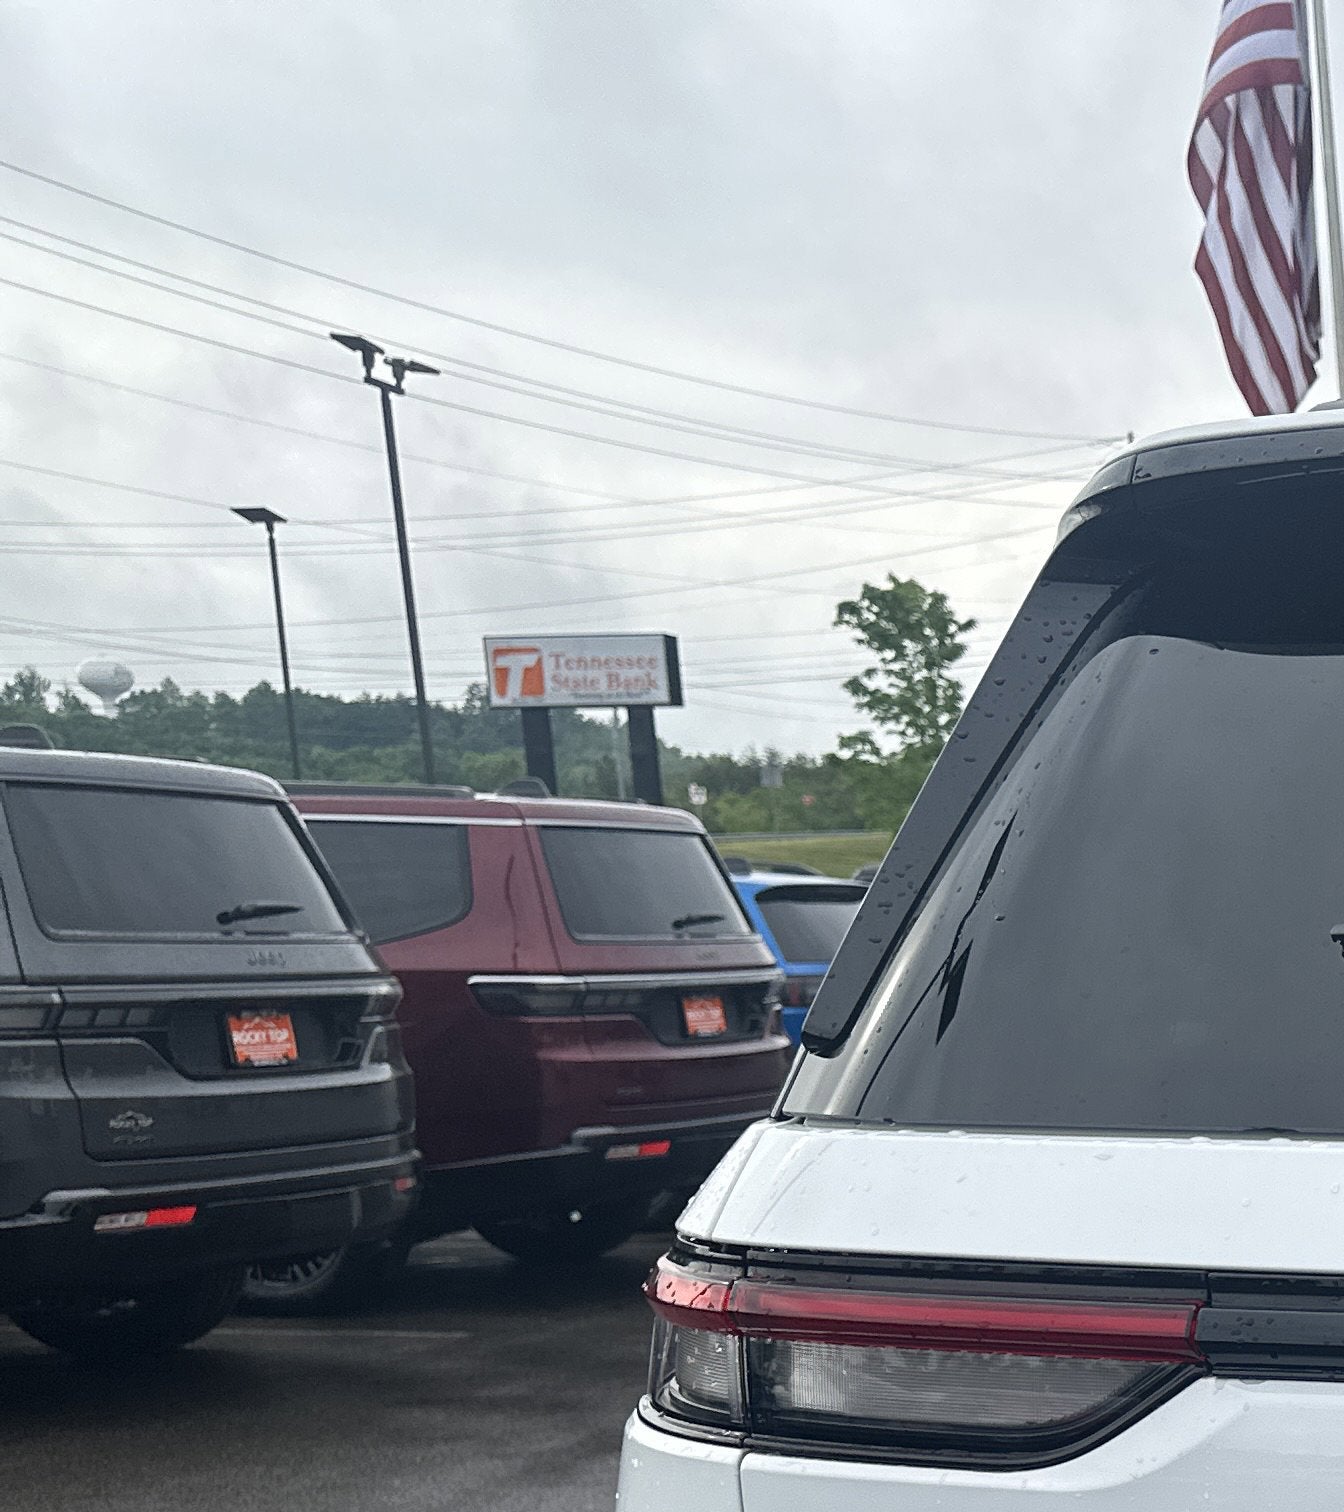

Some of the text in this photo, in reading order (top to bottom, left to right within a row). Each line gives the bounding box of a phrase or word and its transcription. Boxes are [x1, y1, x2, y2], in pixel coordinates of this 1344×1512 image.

[548, 652, 658, 671] Tennessee
[551, 671, 658, 691] State Bank
